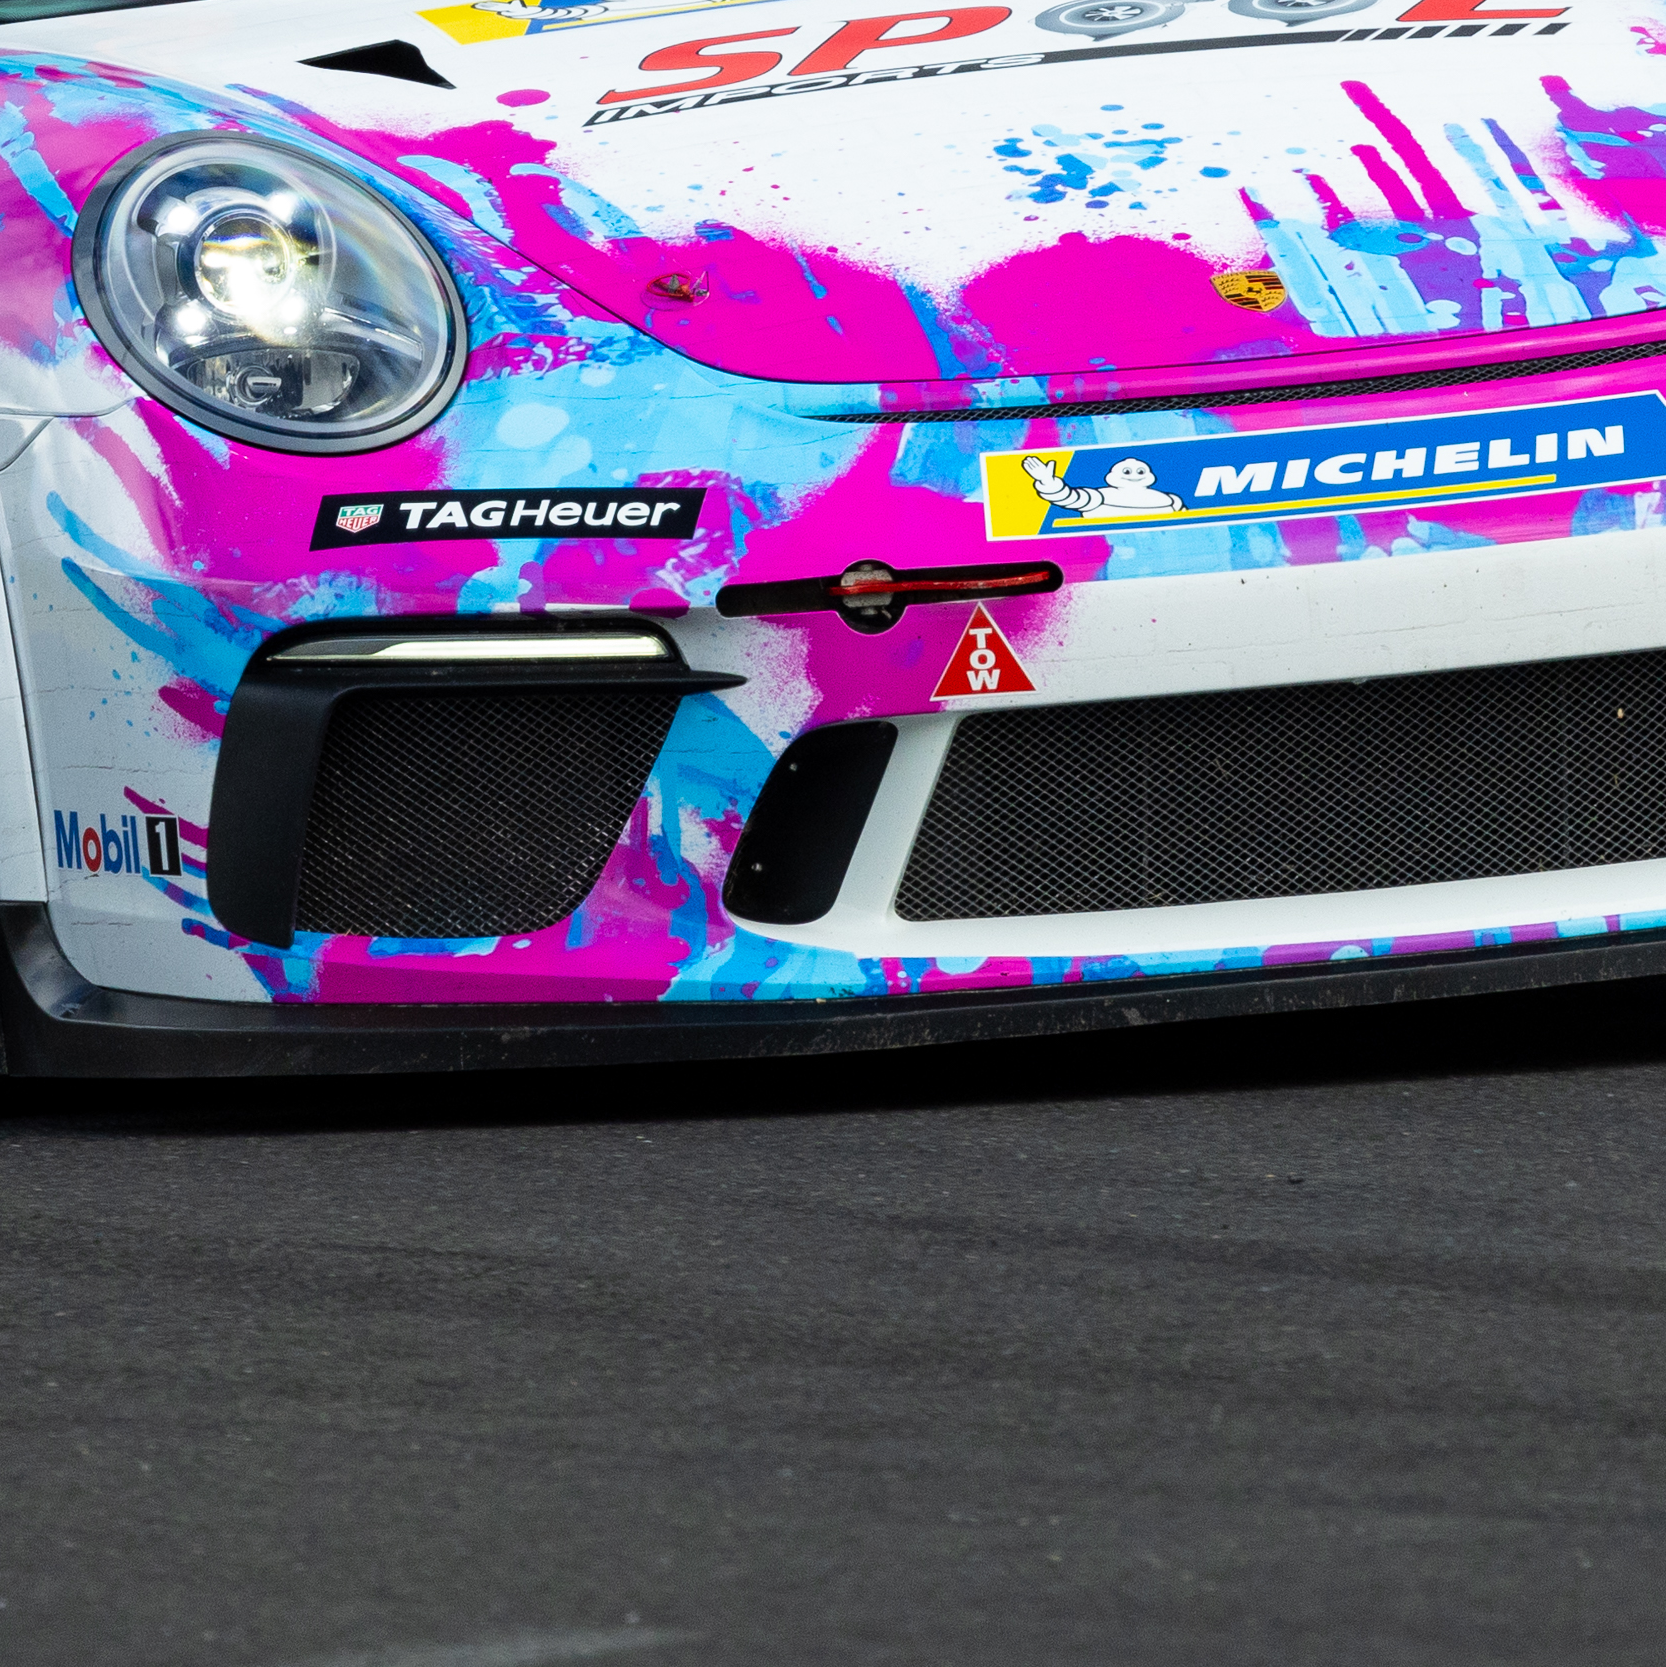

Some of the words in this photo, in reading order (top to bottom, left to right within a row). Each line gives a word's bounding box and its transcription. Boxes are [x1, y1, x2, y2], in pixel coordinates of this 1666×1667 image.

[595, 52, 1047, 123] IMPORTS
[1193, 424, 1625, 497] MICHELIN
[339, 516, 378, 530] HEUER
[343, 506, 379, 517] TAG
[965, 627, 1001, 692] TOW
[53, 809, 141, 875] Mobil
